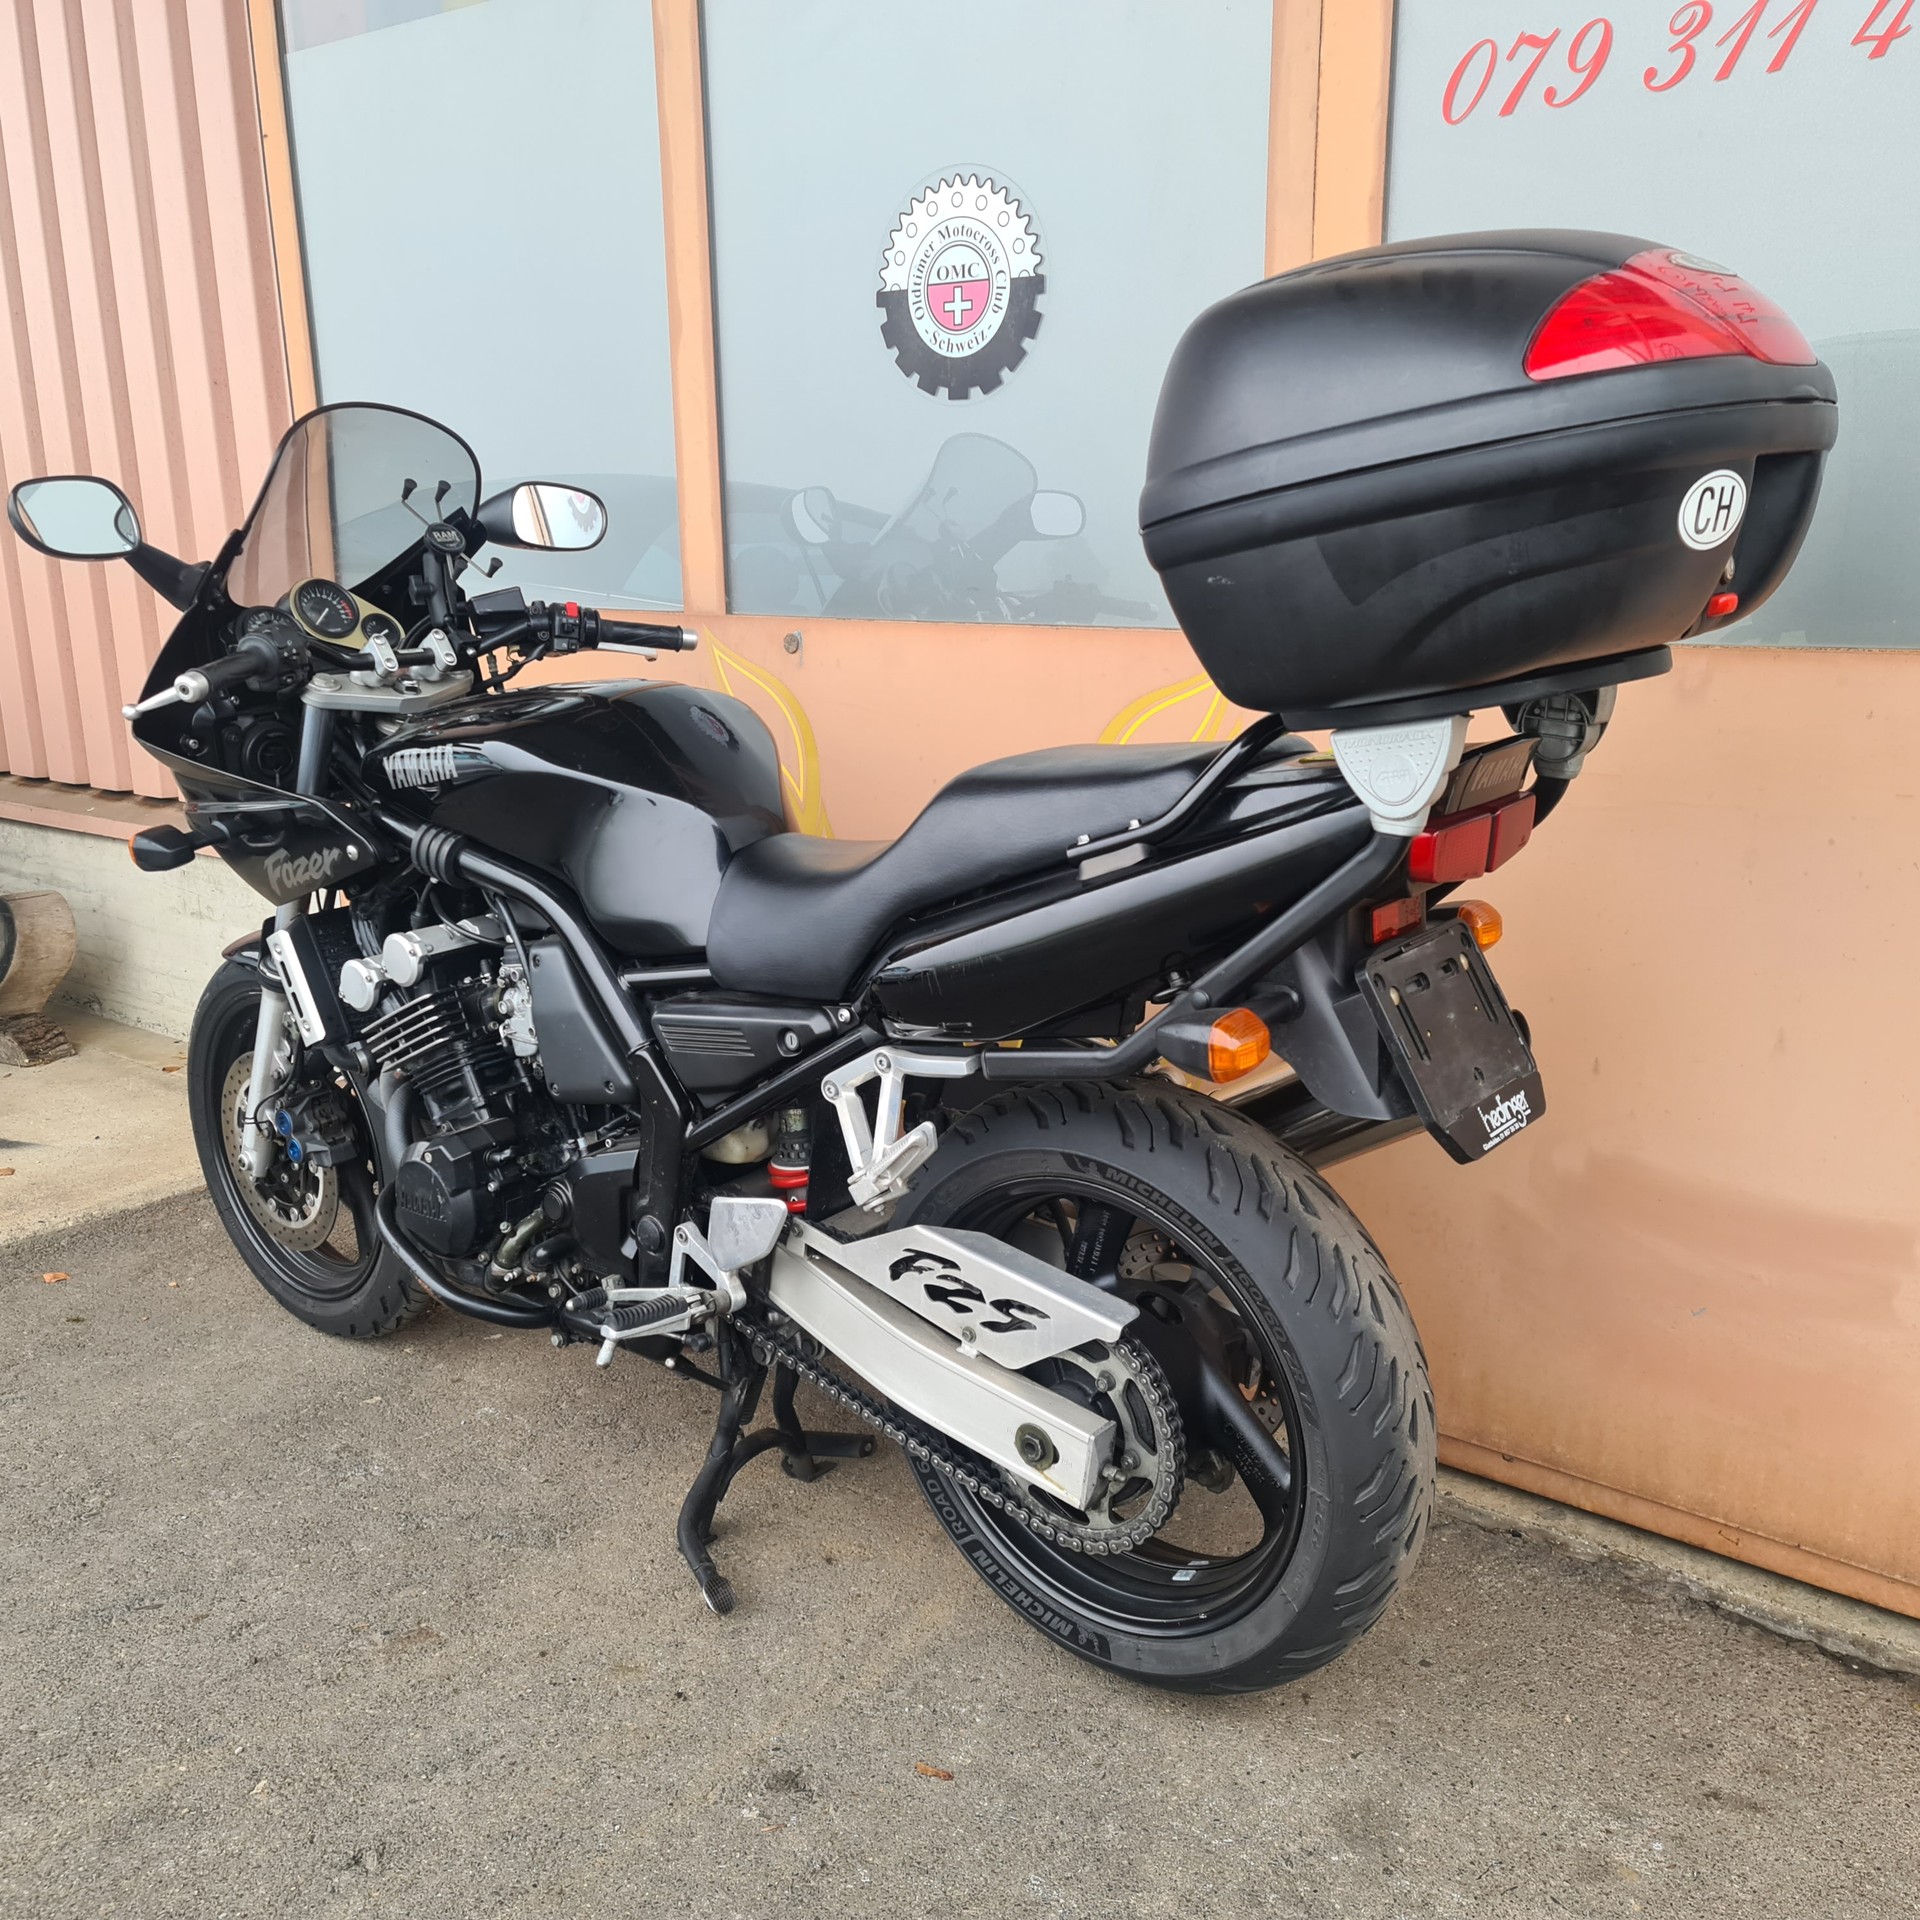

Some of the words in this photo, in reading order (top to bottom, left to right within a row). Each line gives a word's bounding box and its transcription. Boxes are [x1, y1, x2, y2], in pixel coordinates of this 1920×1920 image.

[1442, 17, 1614, 126] 079
[1643, 0, 1819, 92] 311
[912, 240, 935, 321] Oldtimer
[937, 223, 1001, 265] Motocross
[991, 269, 1007, 314] Club
[936, 262, 980, 281] OMC
[929, 330, 988, 353] Schweiz
[1694, 484, 1736, 535] CH
[382, 743, 458, 791] YAMAHA
[264, 846, 342, 897] Fazer
[1105, 1168, 1222, 1251] MICHELIN
[926, 1479, 968, 1536] ROAD
[971, 1549, 1074, 1637] MICHELIN
